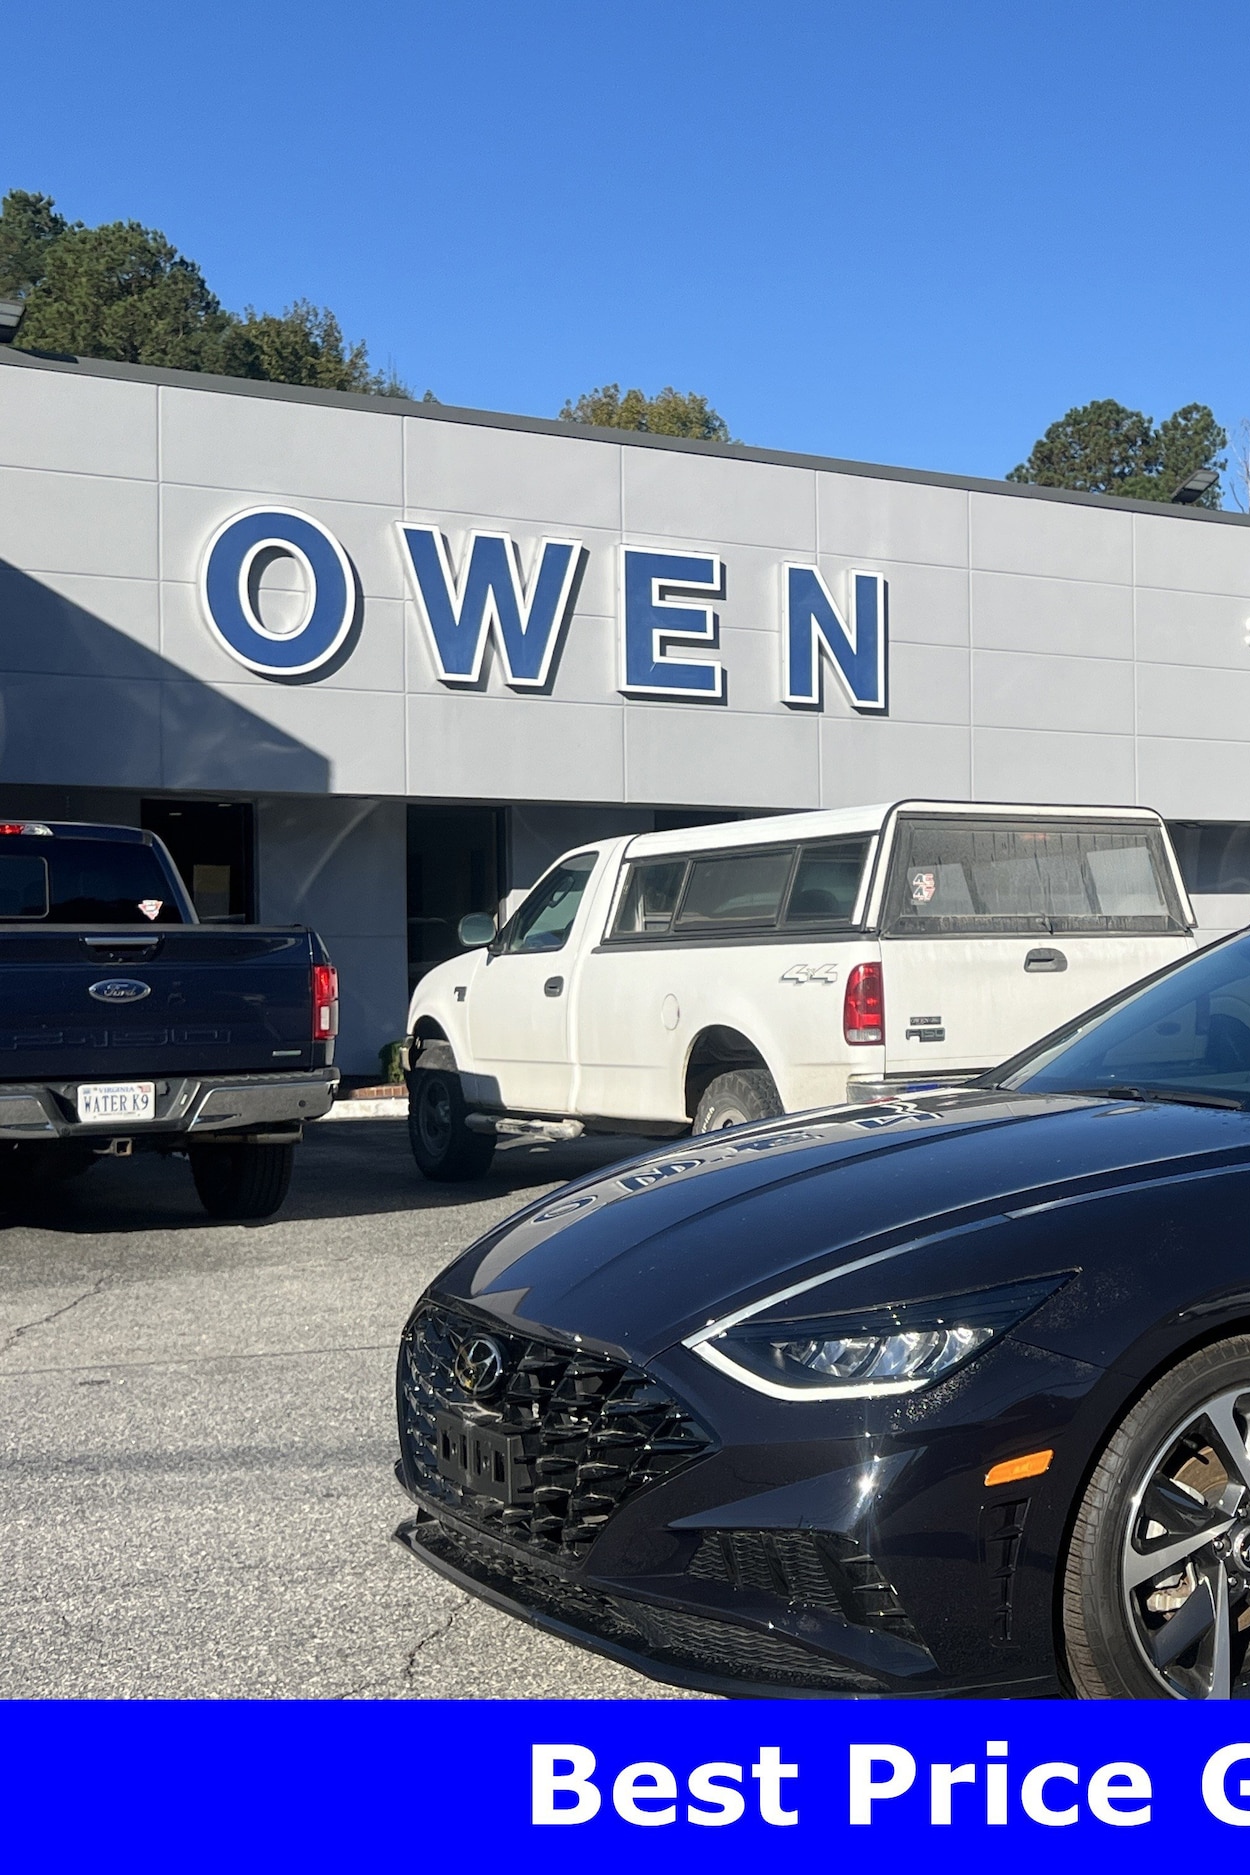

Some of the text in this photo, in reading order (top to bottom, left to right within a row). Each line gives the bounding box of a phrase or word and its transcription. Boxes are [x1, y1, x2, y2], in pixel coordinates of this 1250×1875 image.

[200, 505, 886, 711] OWEN
[98, 1086, 135, 1094] VIRGINIA
[84, 1093, 149, 1113] WATER K9
